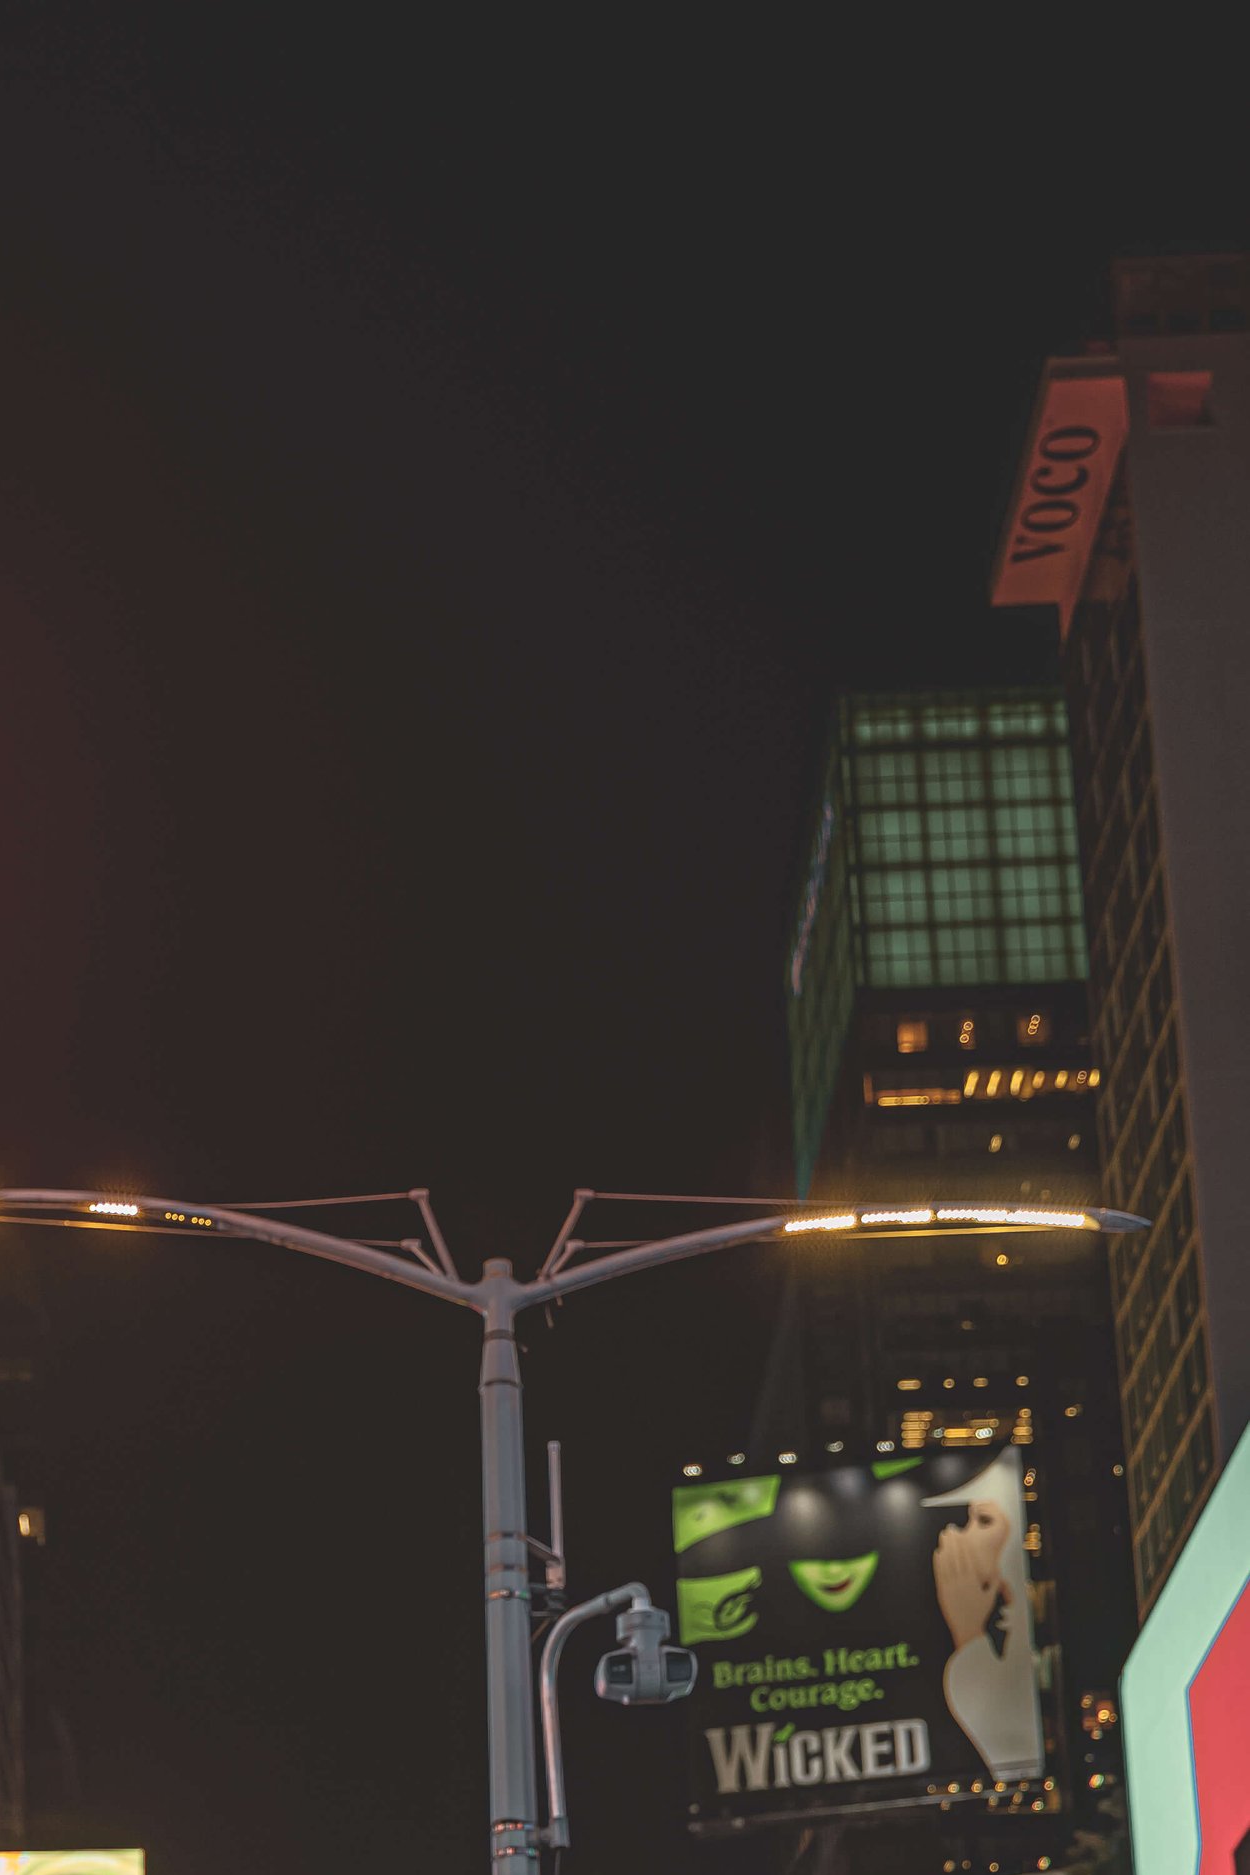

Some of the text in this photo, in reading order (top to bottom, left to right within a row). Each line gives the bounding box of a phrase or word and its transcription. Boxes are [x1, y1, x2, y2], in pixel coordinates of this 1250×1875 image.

[712, 1641, 920, 1690] Brains. Heart.
[750, 1677, 884, 1712] Courage.
